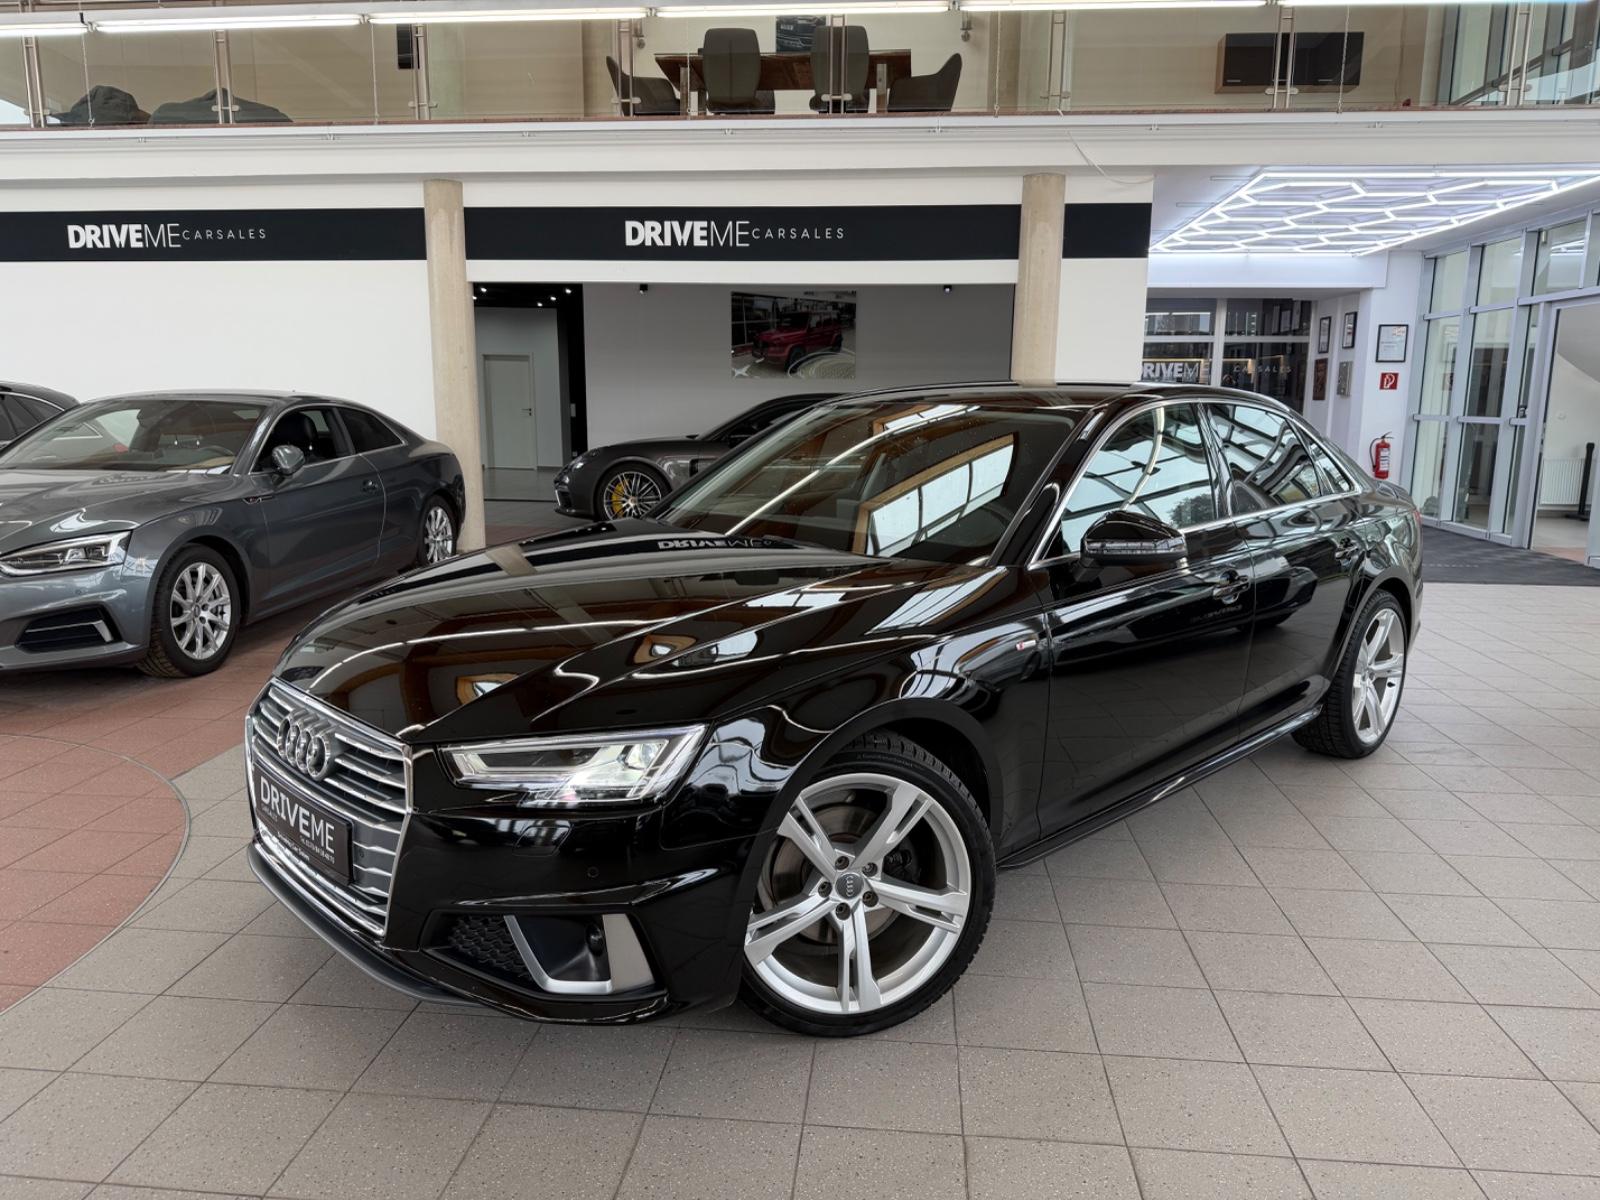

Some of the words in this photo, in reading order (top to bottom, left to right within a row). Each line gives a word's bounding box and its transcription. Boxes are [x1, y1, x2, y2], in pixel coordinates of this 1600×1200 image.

[182, 228, 267, 241] CARSALES
[751, 227, 845, 240] CARSALES
[260, 775, 335, 854] DRIVEME
